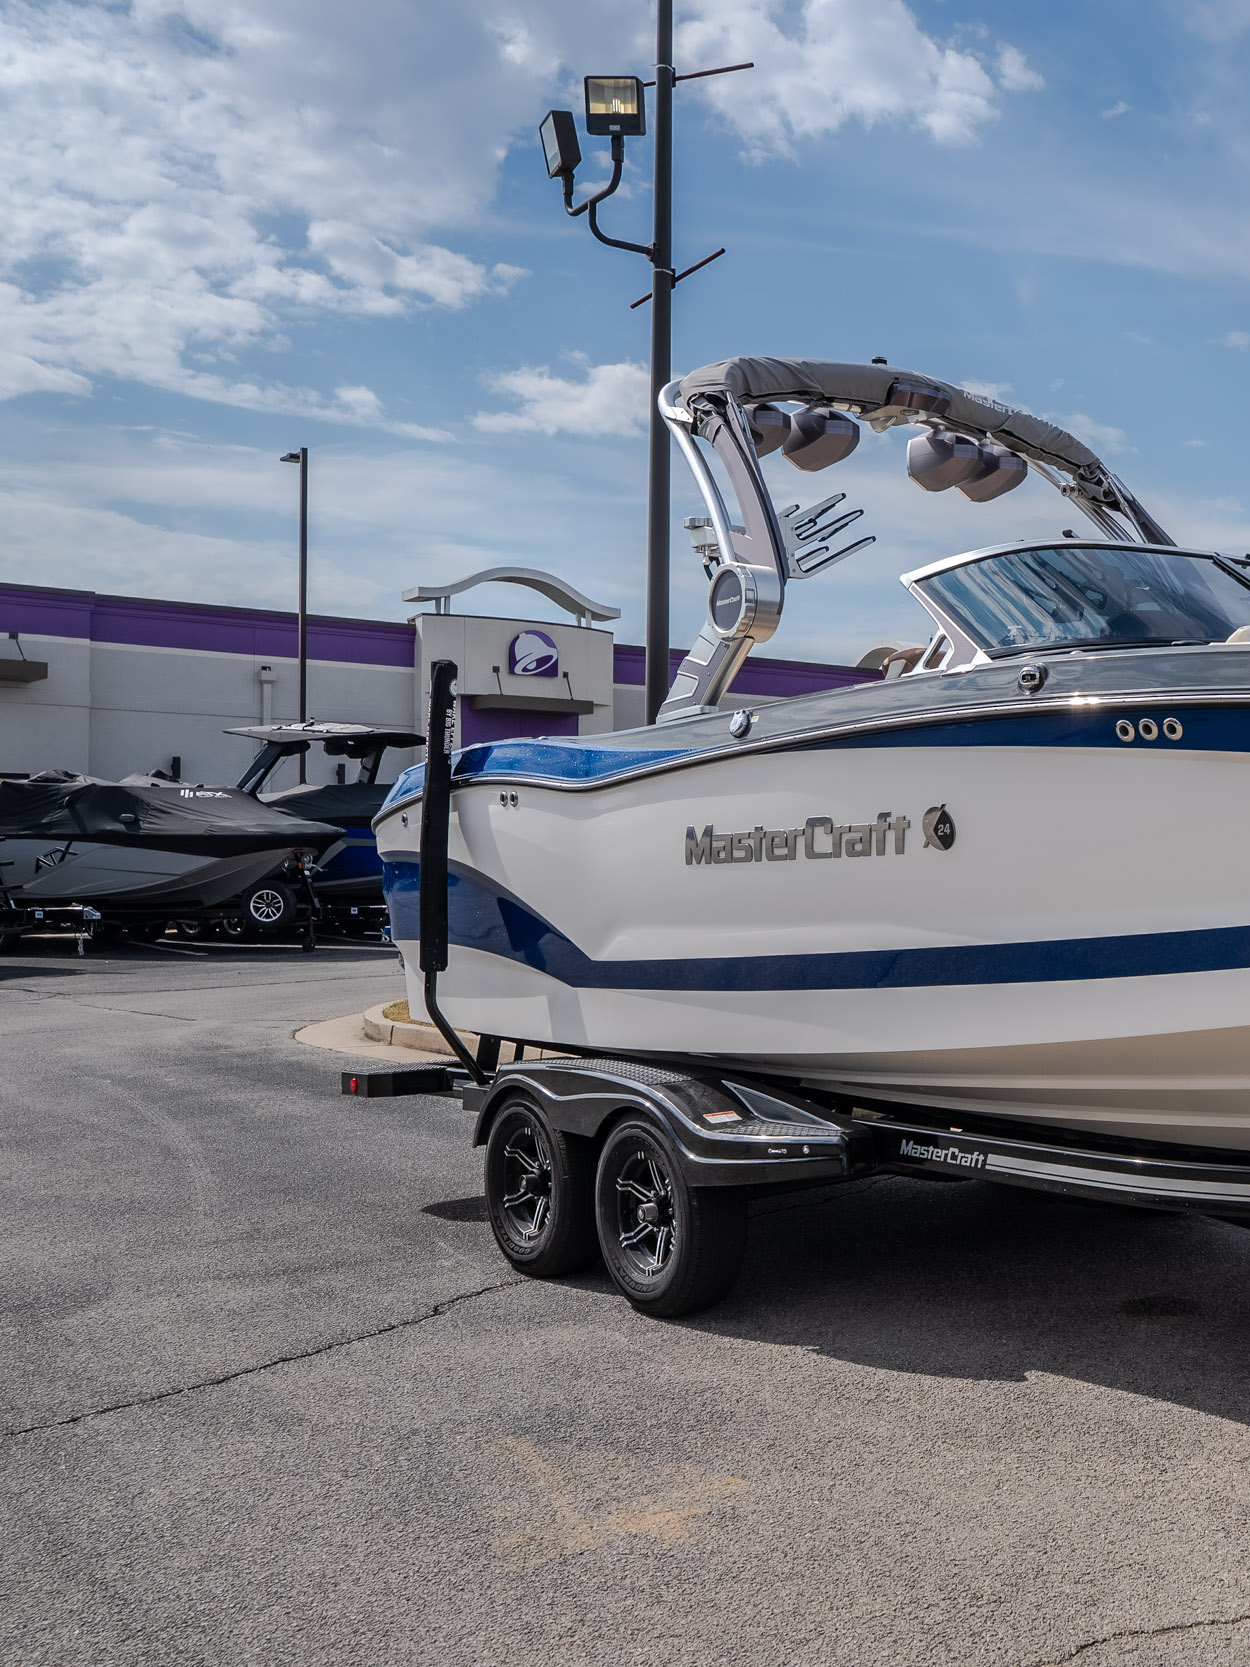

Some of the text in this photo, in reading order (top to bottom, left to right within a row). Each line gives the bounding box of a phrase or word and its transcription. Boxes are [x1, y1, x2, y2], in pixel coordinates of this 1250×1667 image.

[685, 811, 951, 865] MasterCraft 24
[899, 1139, 985, 1169] MasterCraft
